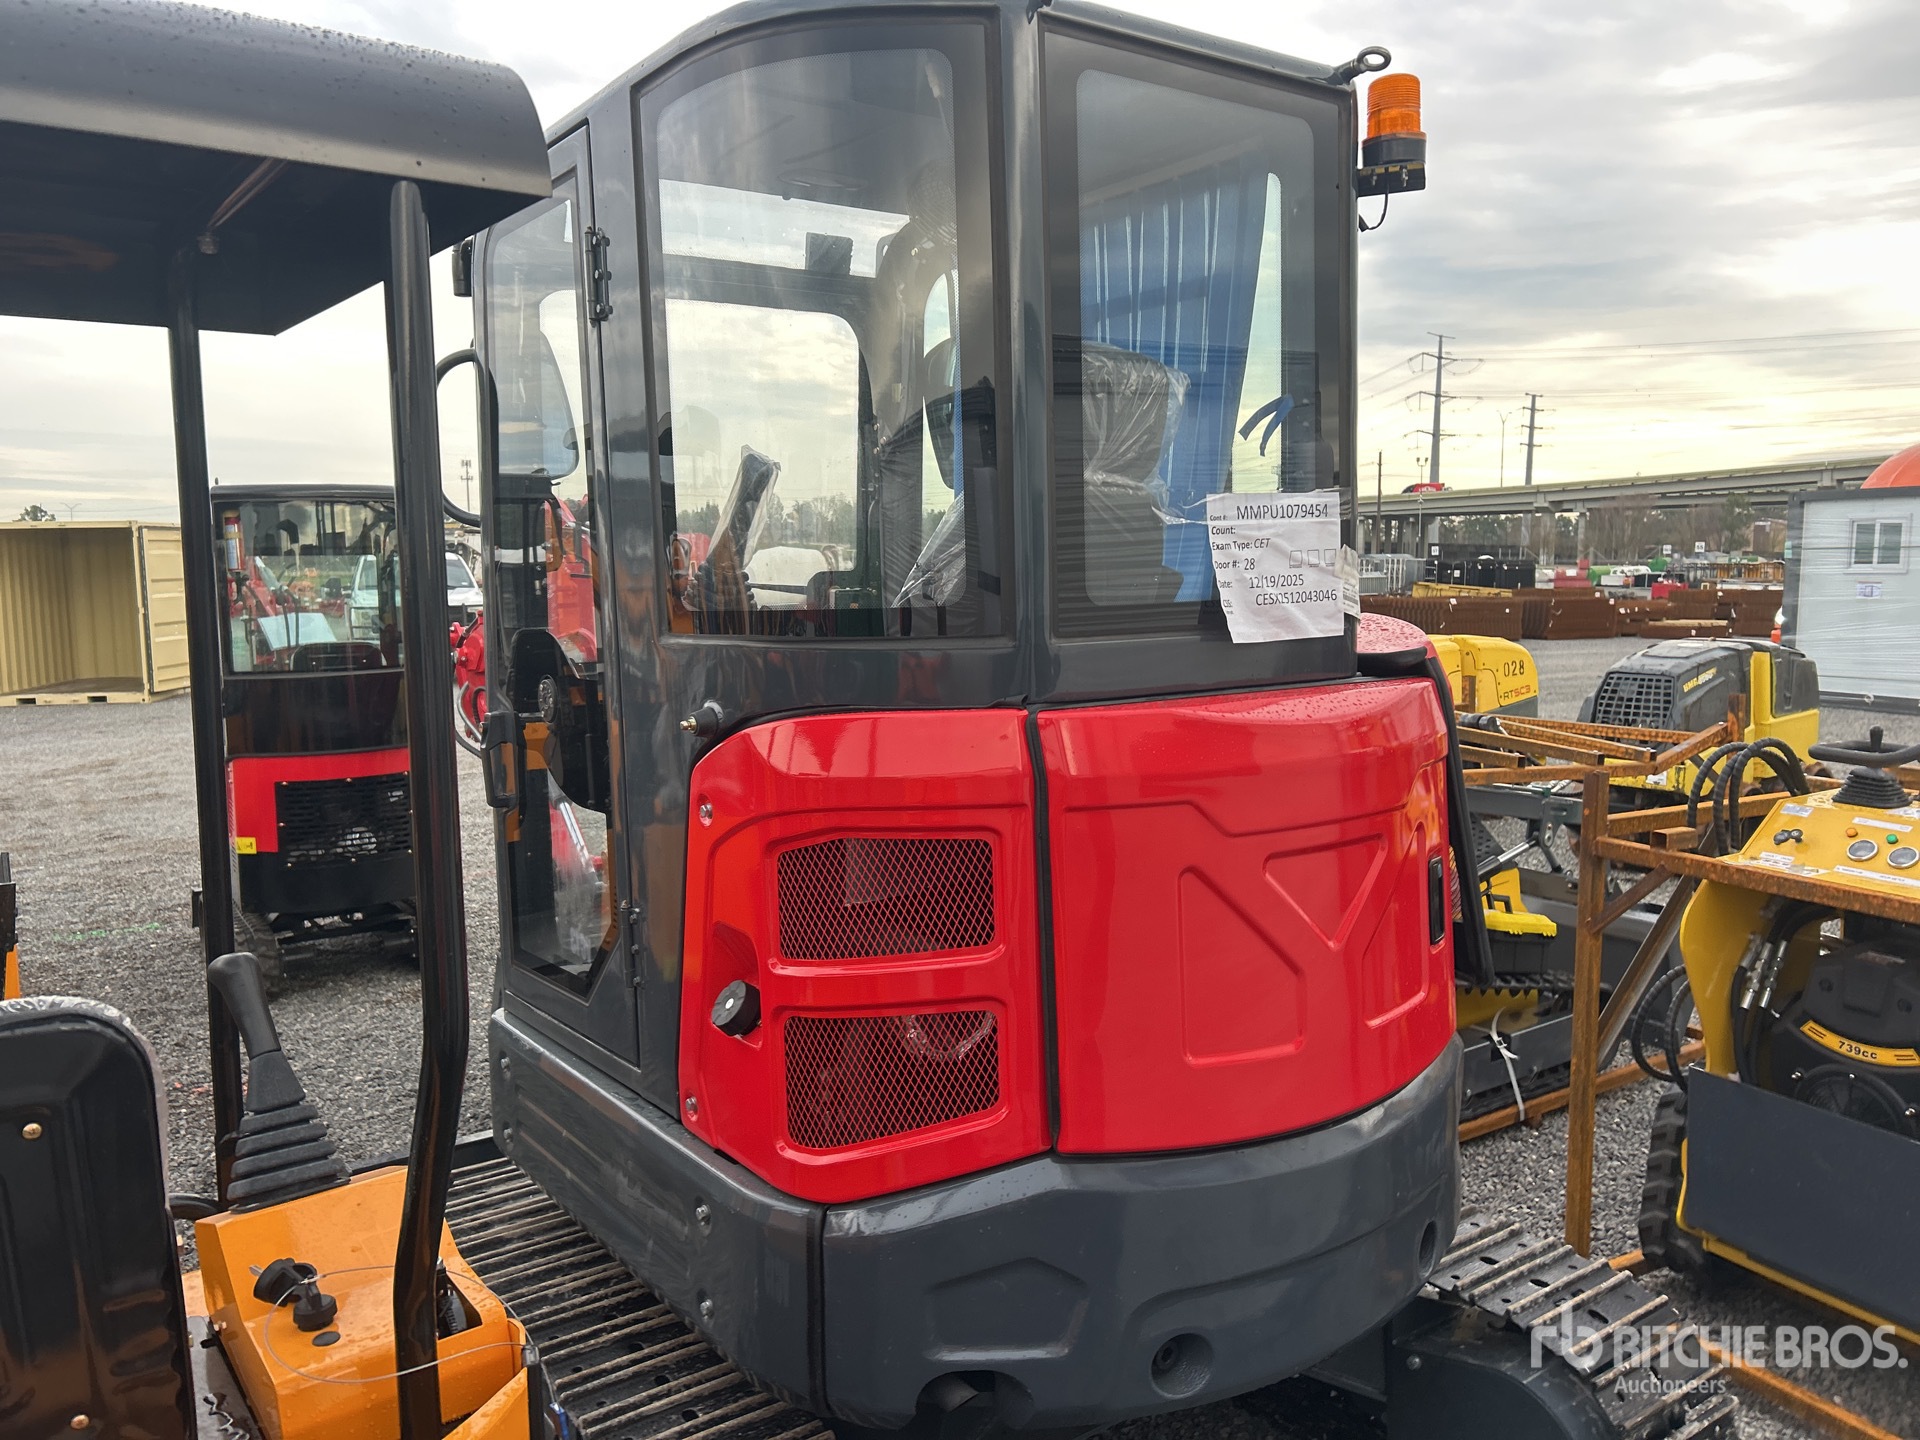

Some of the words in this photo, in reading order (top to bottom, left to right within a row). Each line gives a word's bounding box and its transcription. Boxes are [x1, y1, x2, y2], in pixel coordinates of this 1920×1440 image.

[1236, 503, 1329, 520] MMPU1079454
[1211, 526, 1236, 535] Count:
[1212, 541, 1232, 551] Exam
[1232, 540, 1253, 551] Type:
[1253, 537, 1271, 549] CET
[1244, 557, 1256, 571] 28
[1249, 573, 1305, 589] 12/19/2025
[1503, 659, 1525, 677] 028
[1838, 1040, 1878, 1060] 739cc
